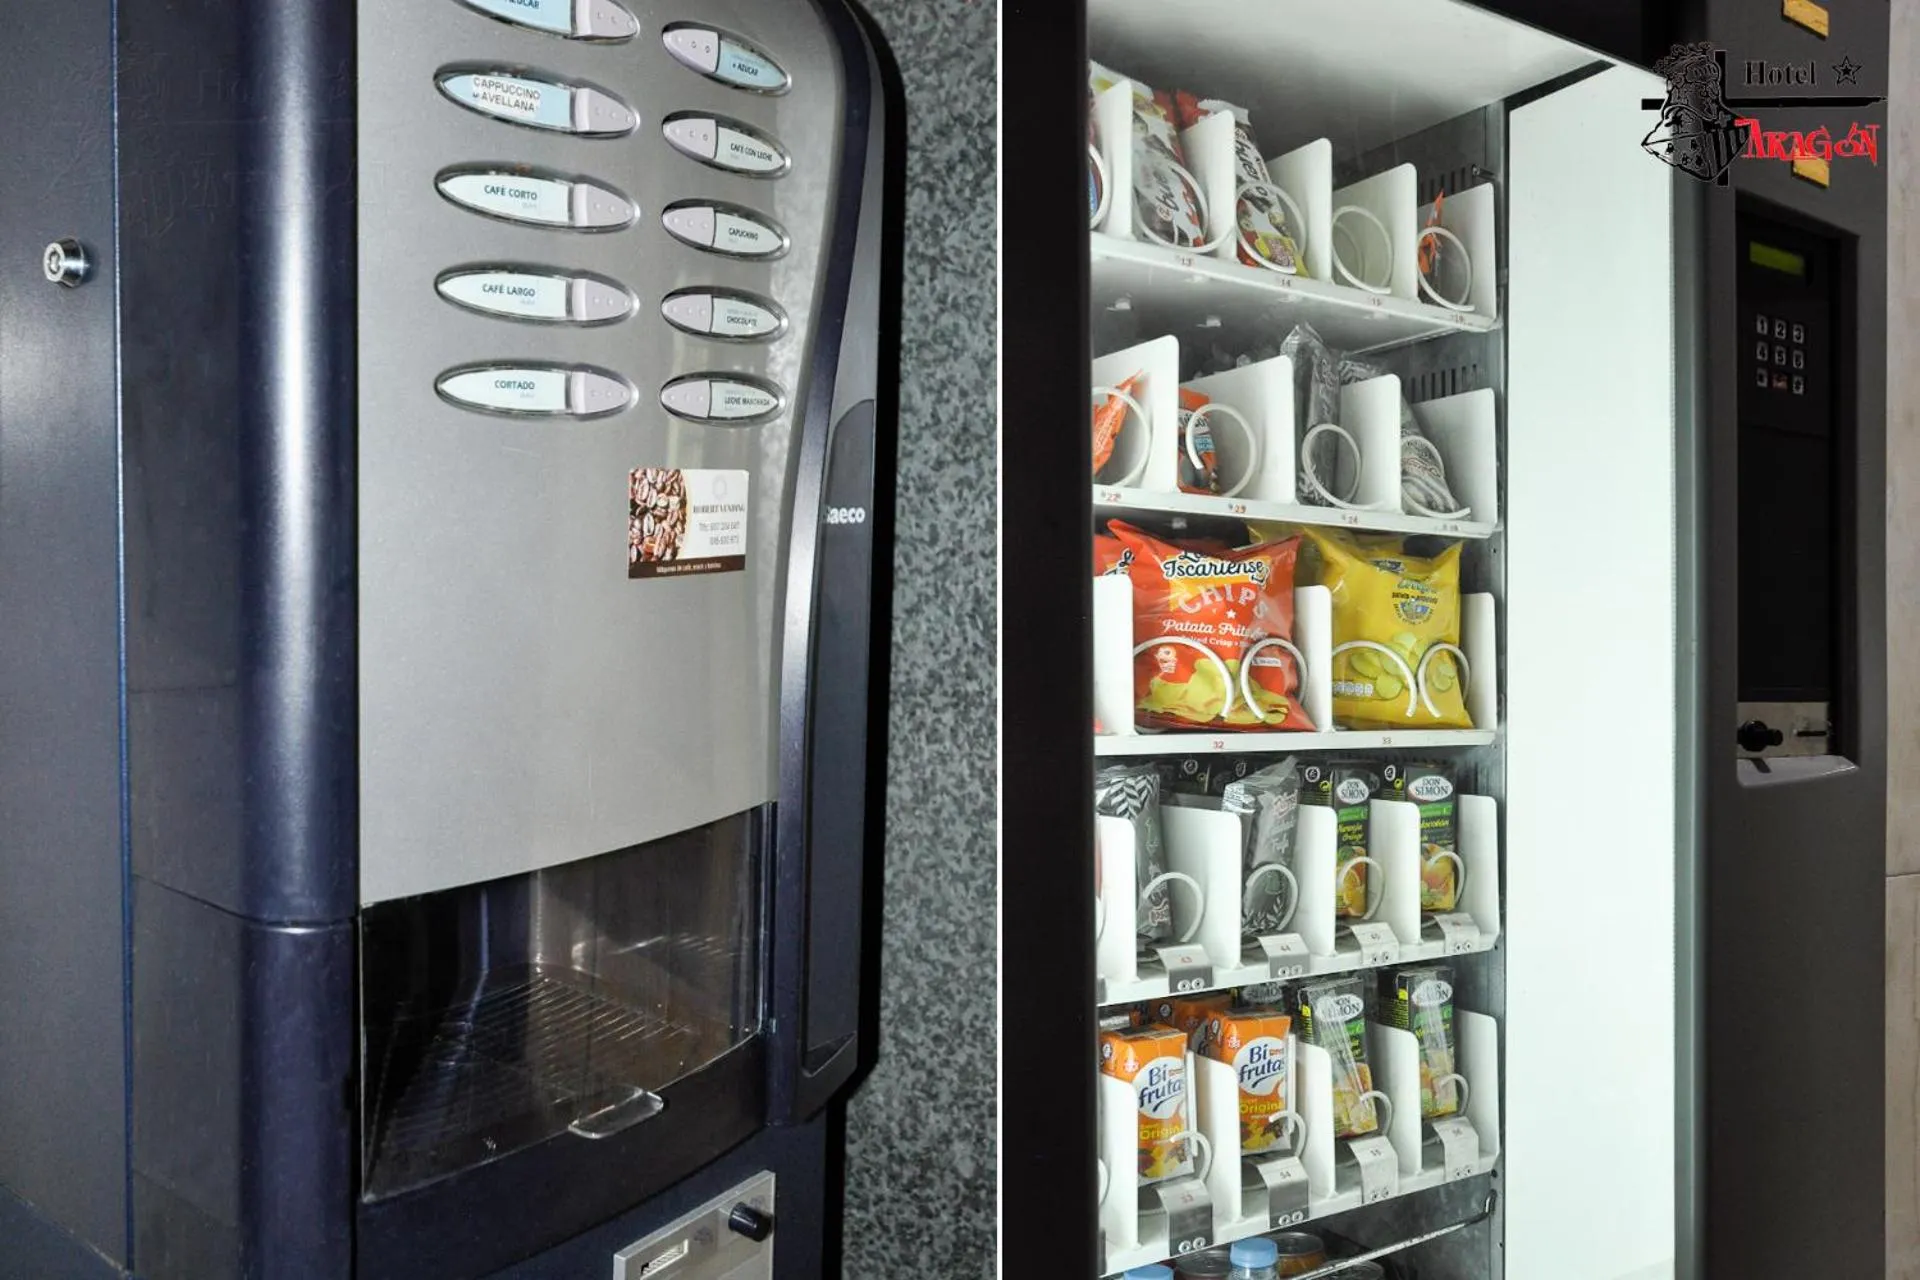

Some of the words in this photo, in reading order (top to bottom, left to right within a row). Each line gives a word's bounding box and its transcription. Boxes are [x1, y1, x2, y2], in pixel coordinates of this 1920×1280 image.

[473, 77, 541, 100] CAPPUCCINO
[481, 91, 534, 111] AVELLANA
[508, 188, 538, 200] CORTO
[506, 286, 536, 297] LARGO
[727, 315, 757, 327] CHOCOLATE
[494, 379, 535, 391] CORTADO
[1178, 583, 1269, 619] CHIPS
[1162, 618, 1215, 635] Patata
[1422, 777, 1441, 786] DON
[1249, 1043, 1268, 1065] Bi
[1149, 1064, 1167, 1086] Bi
